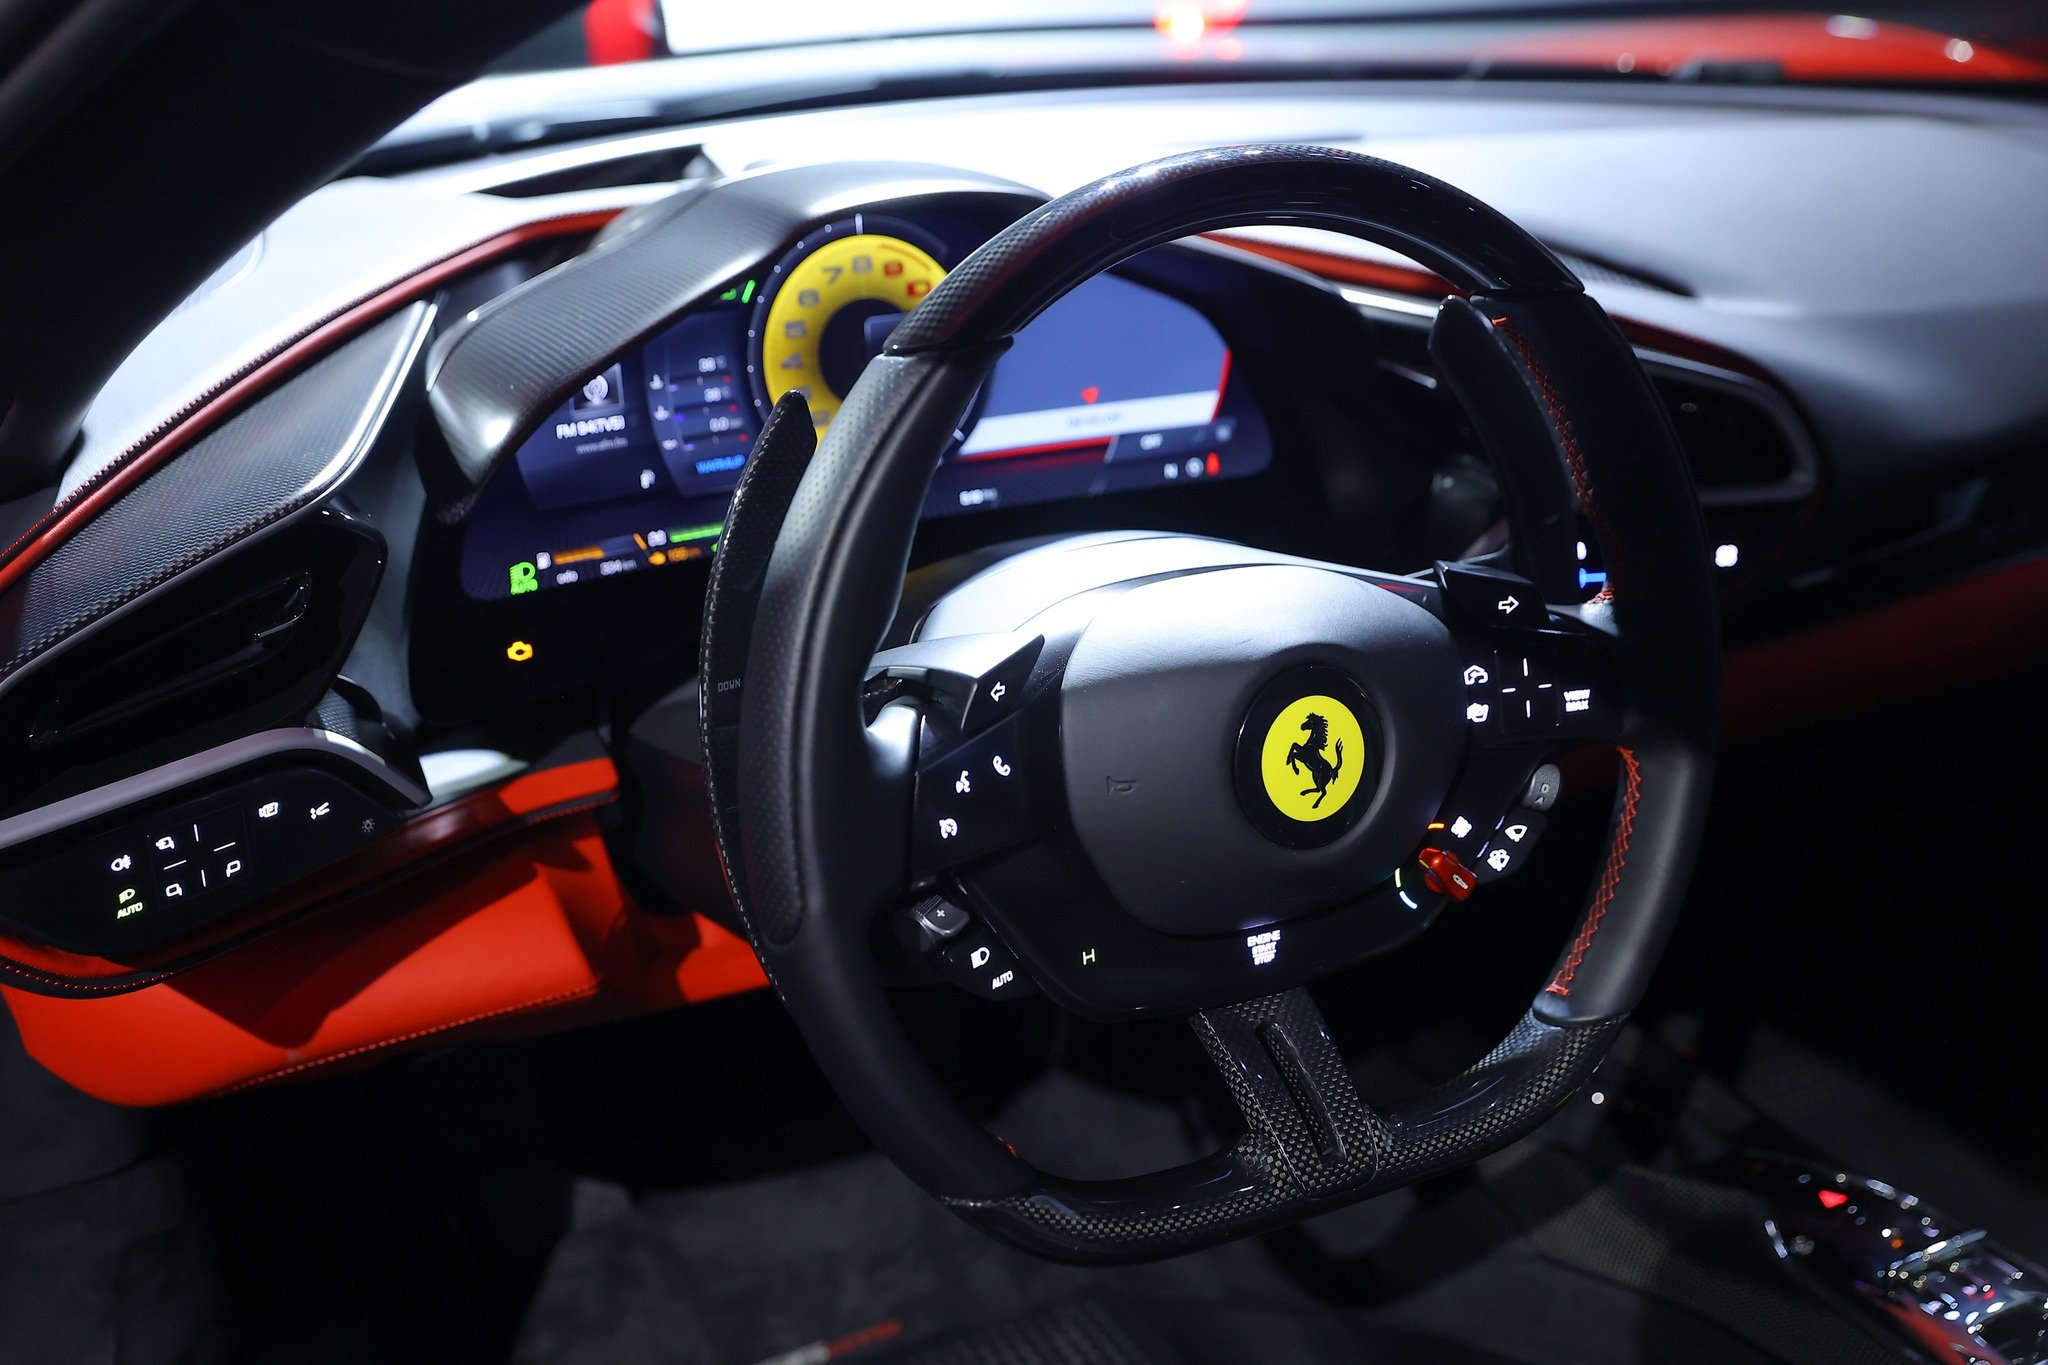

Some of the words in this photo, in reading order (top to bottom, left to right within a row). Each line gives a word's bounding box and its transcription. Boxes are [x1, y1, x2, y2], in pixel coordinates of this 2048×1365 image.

[822, 266, 843, 285] 7
[781, 353, 803, 371] 4
[717, 678, 741, 692] DOWN
[117, 902, 143, 919] AUTO
[1247, 929, 1281, 947] ENGINE
[1252, 941, 1277, 954] START
[1082, 948, 1096, 965] H
[1254, 953, 1275, 965] STOP
[992, 970, 1014, 990] AUTO
